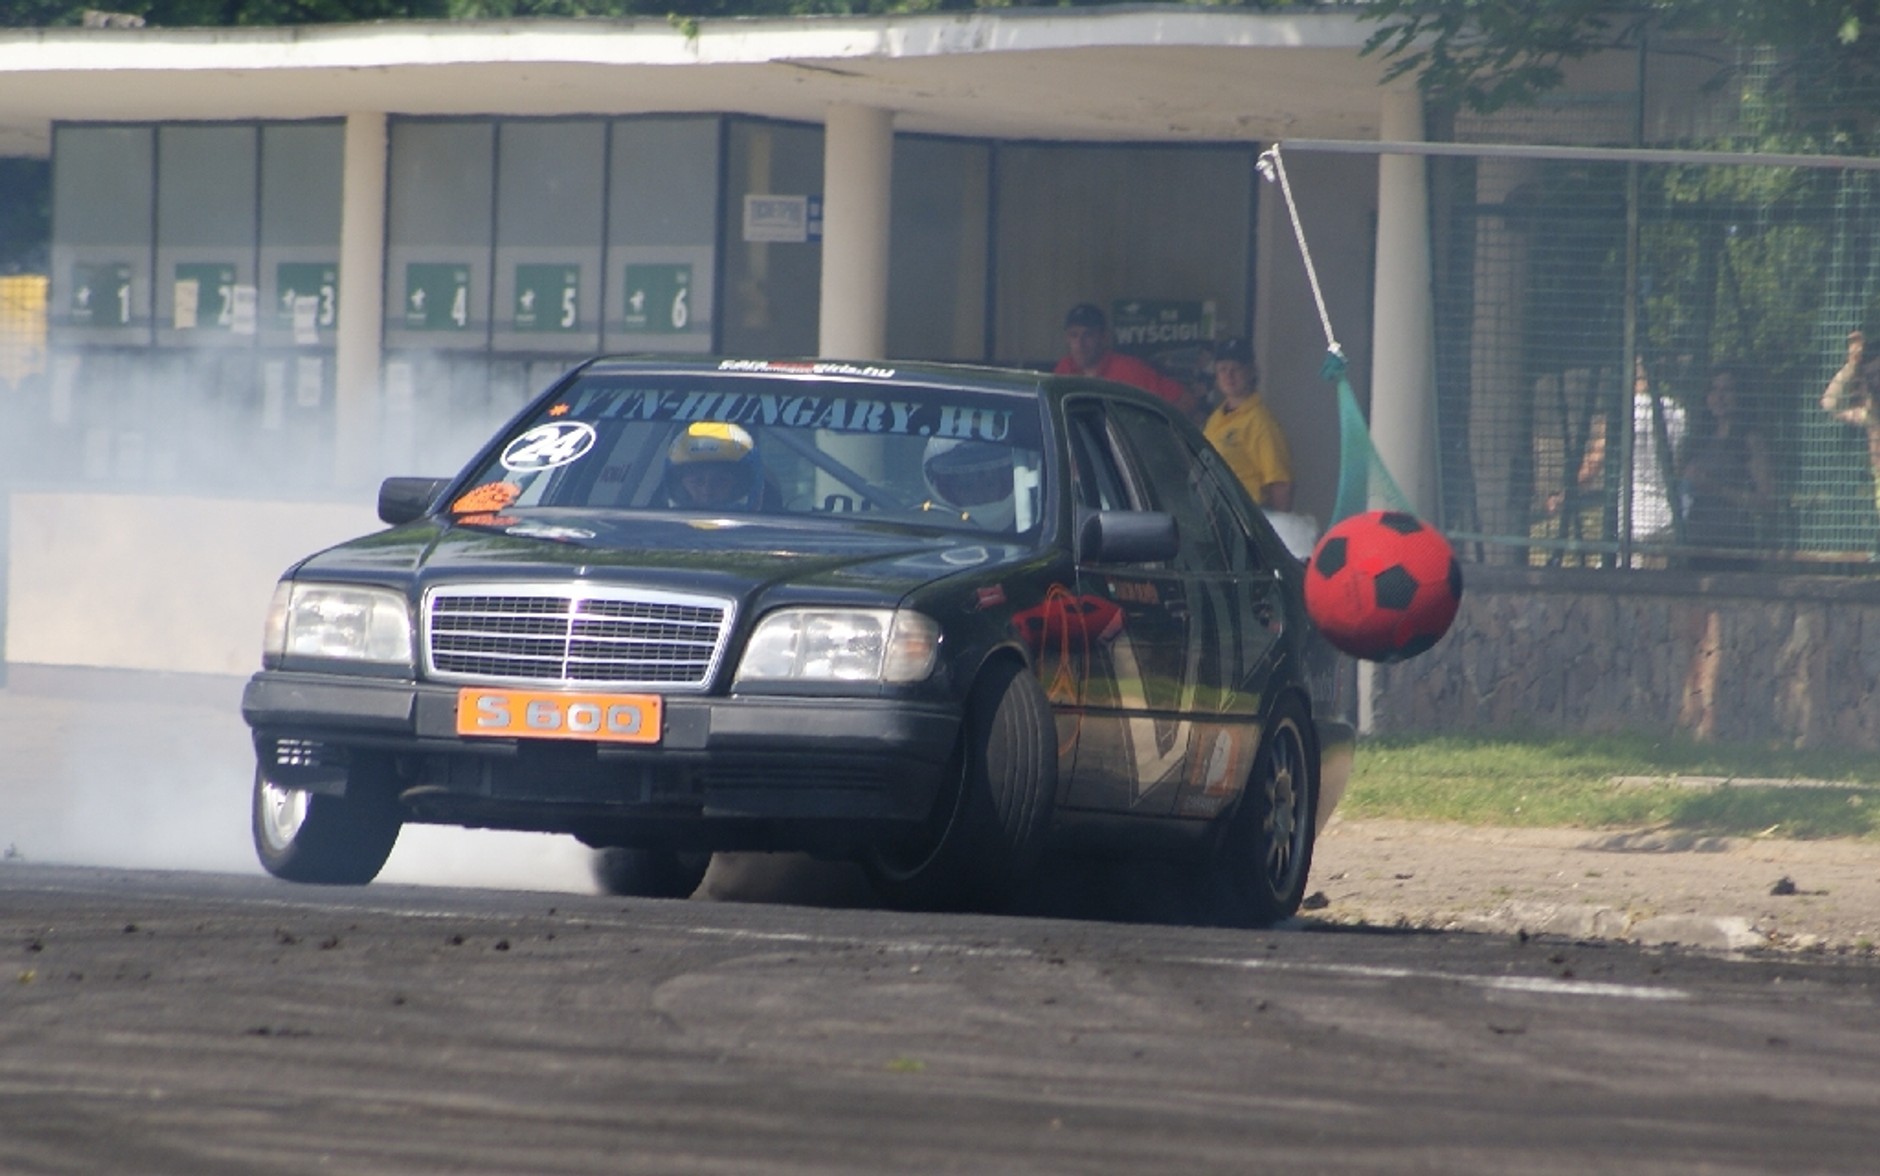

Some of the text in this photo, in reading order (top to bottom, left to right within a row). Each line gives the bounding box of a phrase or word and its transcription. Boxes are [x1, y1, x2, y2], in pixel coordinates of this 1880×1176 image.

[117, 284, 131, 323] 1
[218, 285, 235, 326] 2
[319, 285, 335, 326] 3
[451, 287, 467, 327] 4
[560, 287, 577, 328] 5
[671, 288, 688, 329] 6
[506, 426, 590, 463] 24
[476, 695, 642, 734] S 600
